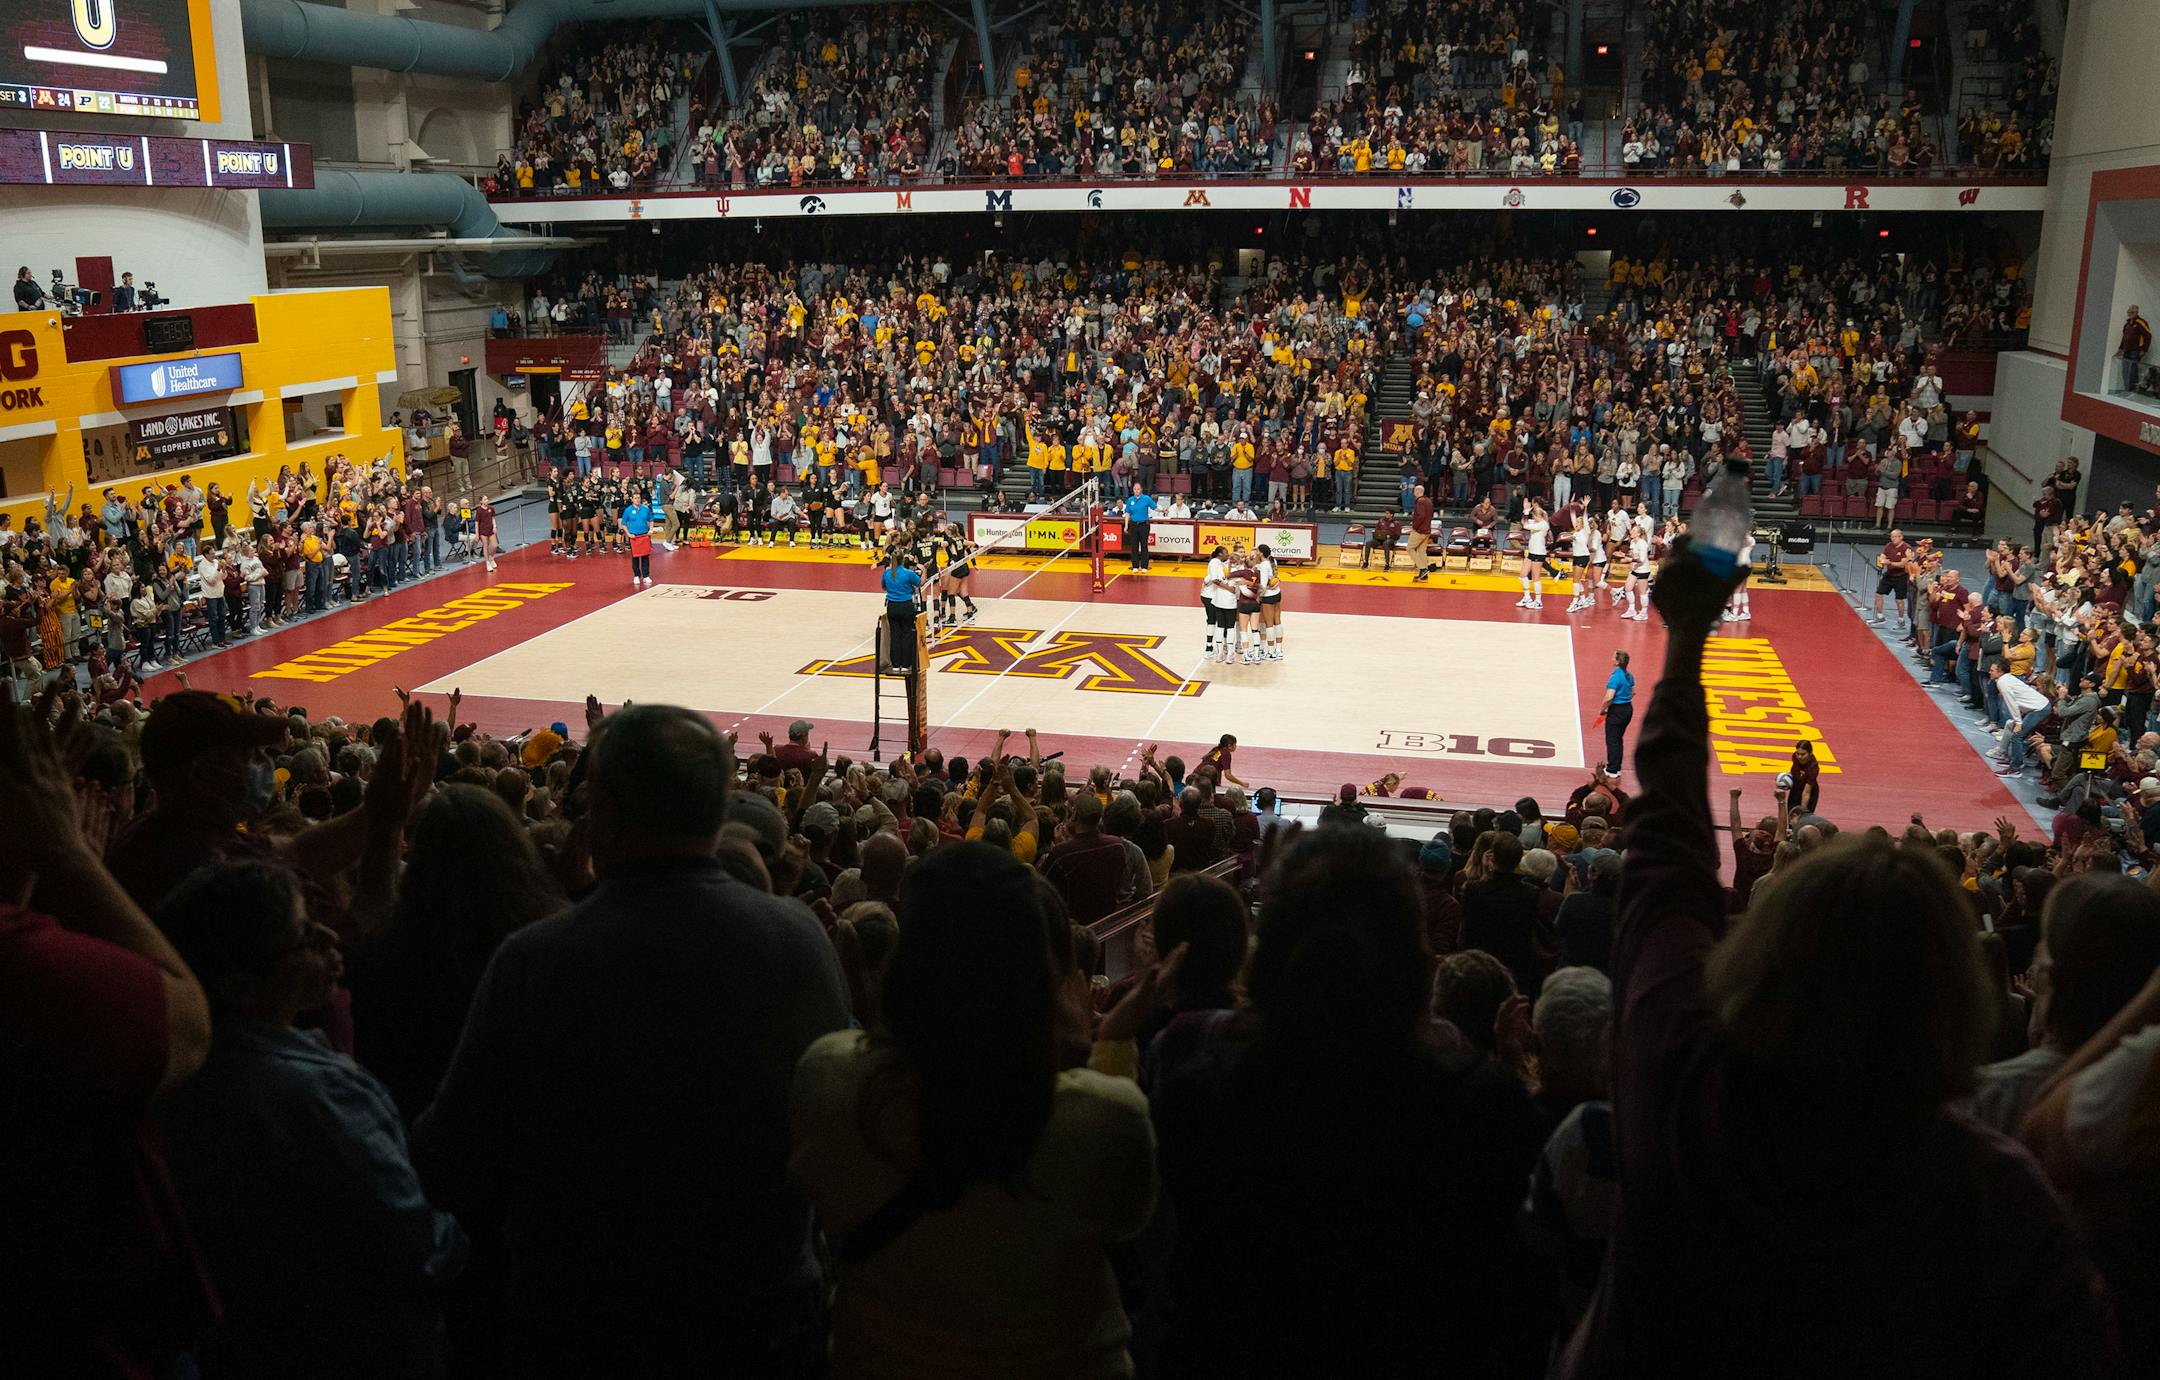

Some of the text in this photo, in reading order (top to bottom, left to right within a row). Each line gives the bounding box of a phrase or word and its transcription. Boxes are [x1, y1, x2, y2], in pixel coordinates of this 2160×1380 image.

[0, 90, 27, 102] SET 3
[57, 93, 71, 107] 24
[58, 144, 134, 171] POINT U
[217, 151, 278, 175] POINT U
[1289, 187, 1311, 209] N
[1844, 186, 1870, 209] R
[168, 364, 198, 379] United
[170, 376, 217, 393] Healthcare
[140, 421, 164, 437] LAND
[203, 412, 221, 427] INC.
[162, 441, 191, 453] GOPHER
[192, 436, 216, 448] BLOCK
[1158, 536, 1191, 544] TOYOTA
[1221, 535, 1250, 543] HEALTH
[248, 582, 577, 683] MINNESOTA
